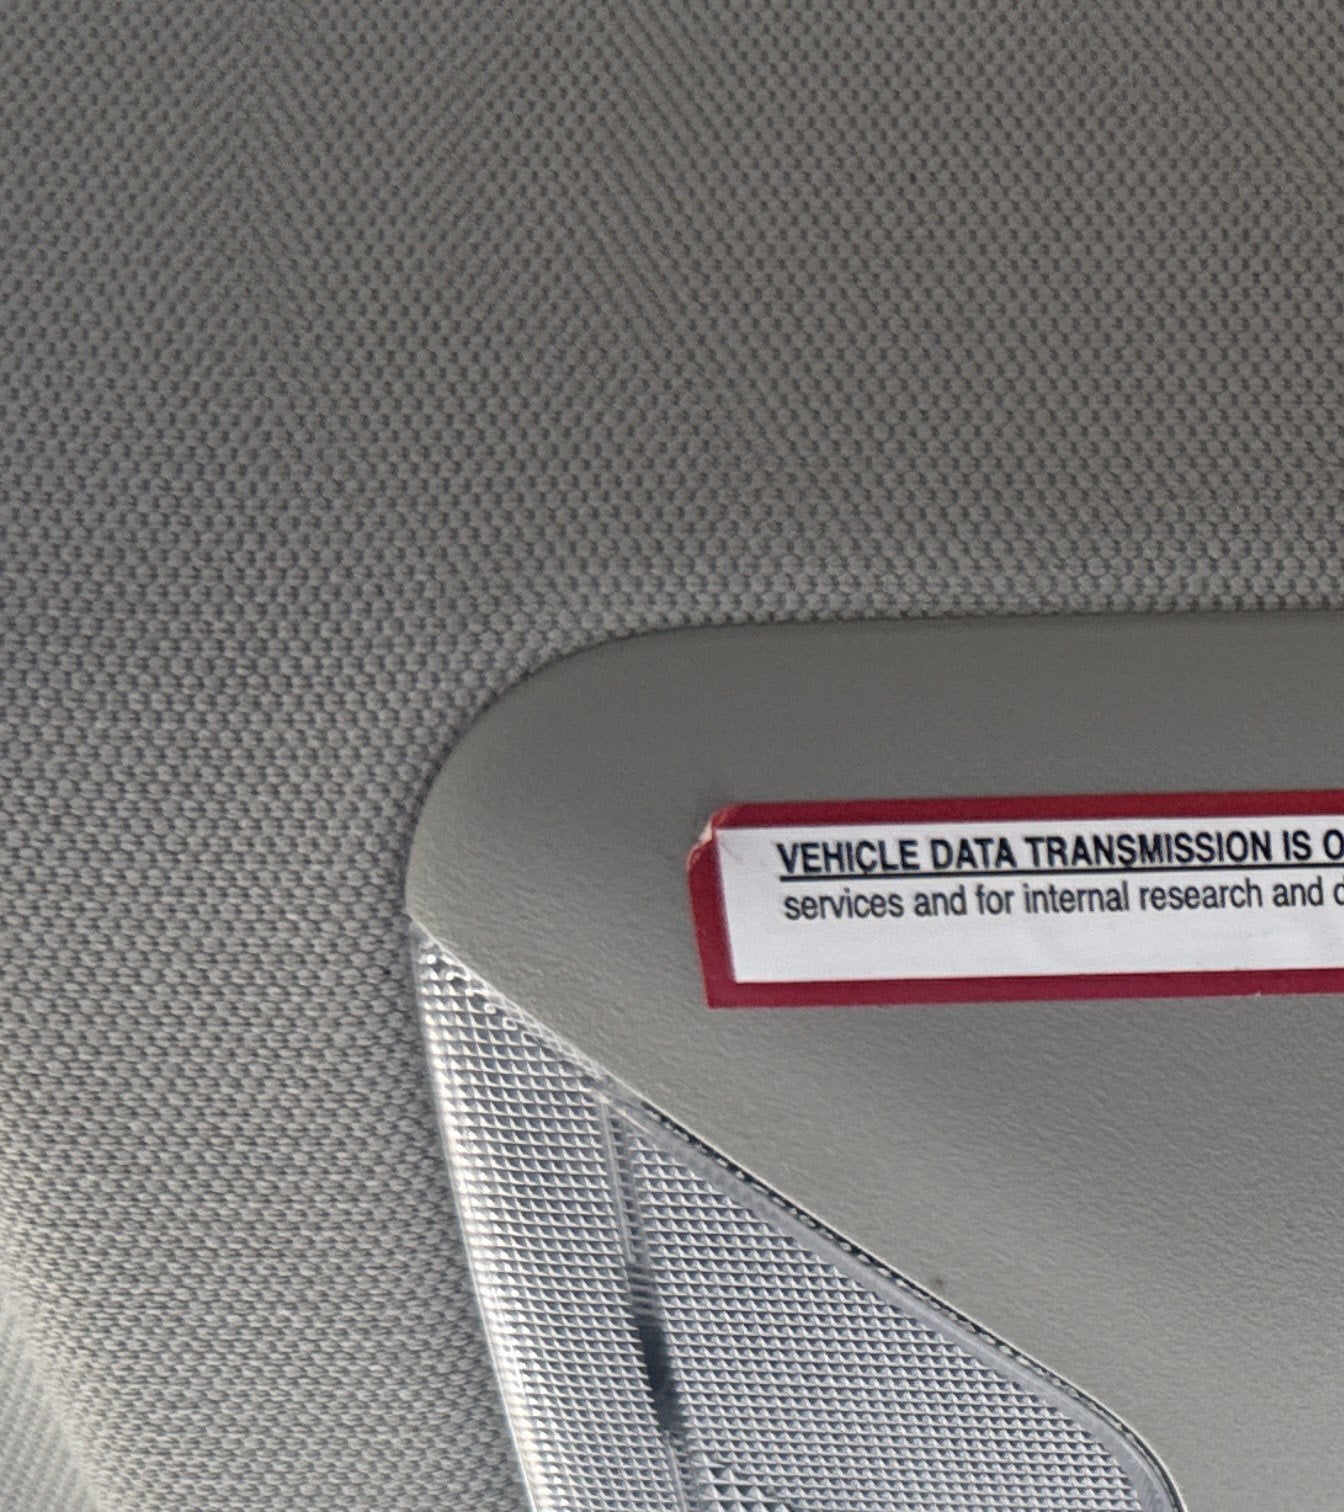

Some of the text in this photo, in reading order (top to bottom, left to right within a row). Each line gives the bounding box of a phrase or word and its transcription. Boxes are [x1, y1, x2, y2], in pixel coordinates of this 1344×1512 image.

[776, 839, 919, 875] VEHICLE
[931, 836, 1018, 871] DATA
[1024, 830, 1269, 869] TRANSMISSION
[1283, 829, 1313, 861] IS
[784, 886, 904, 921] services
[914, 884, 966, 918] and
[976, 883, 1015, 915] for
[1023, 880, 1129, 914] internal
[1139, 877, 1263, 910] research
[1273, 876, 1323, 907] and
